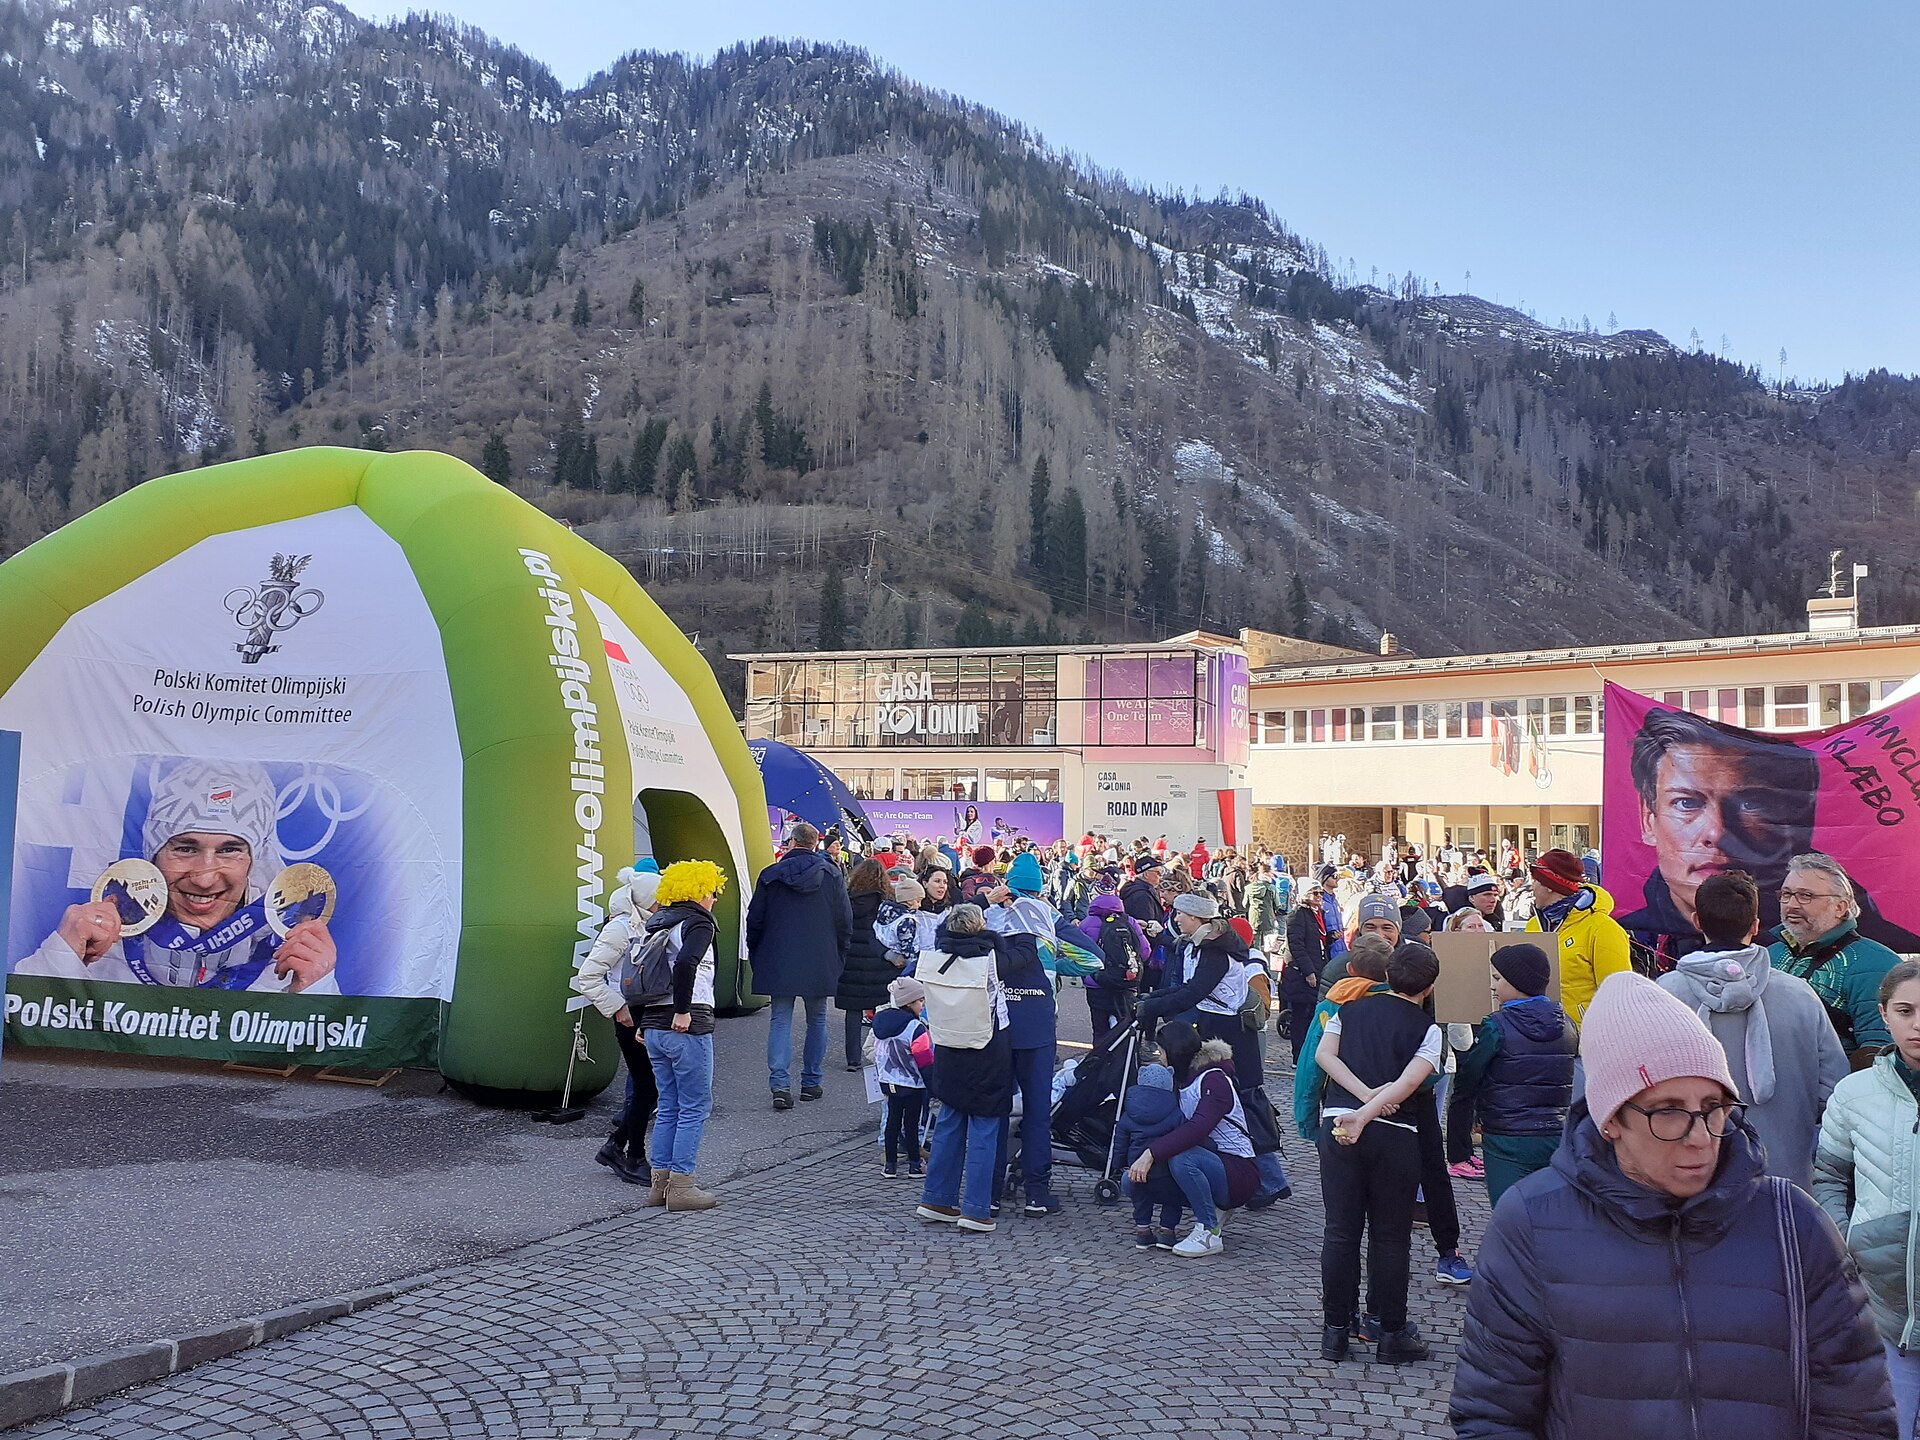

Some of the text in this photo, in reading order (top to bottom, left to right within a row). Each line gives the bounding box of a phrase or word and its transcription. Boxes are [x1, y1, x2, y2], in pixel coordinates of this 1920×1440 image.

[153, 669, 347, 700] Polski Komitet Olimpijski
[875, 671, 933, 700] CASA
[133, 694, 352, 726] Polish Olympic Committee
[1116, 700, 1155, 709] We Are
[874, 704, 980, 735] POLONIA
[1107, 711, 1163, 722] One Team
[1097, 771, 1117, 781] CASA
[1097, 782, 1131, 791] POLONIA
[1823, 735, 1905, 826] KLÆBO
[872, 811, 933, 820] We Are One Team
[1107, 801, 1168, 817] ROAD MAP
[208, 913, 254, 948] SOCHI
[1013, 988, 1045, 996] CORTINA
[5, 993, 369, 1053] Polski Komitet Olimpijski
